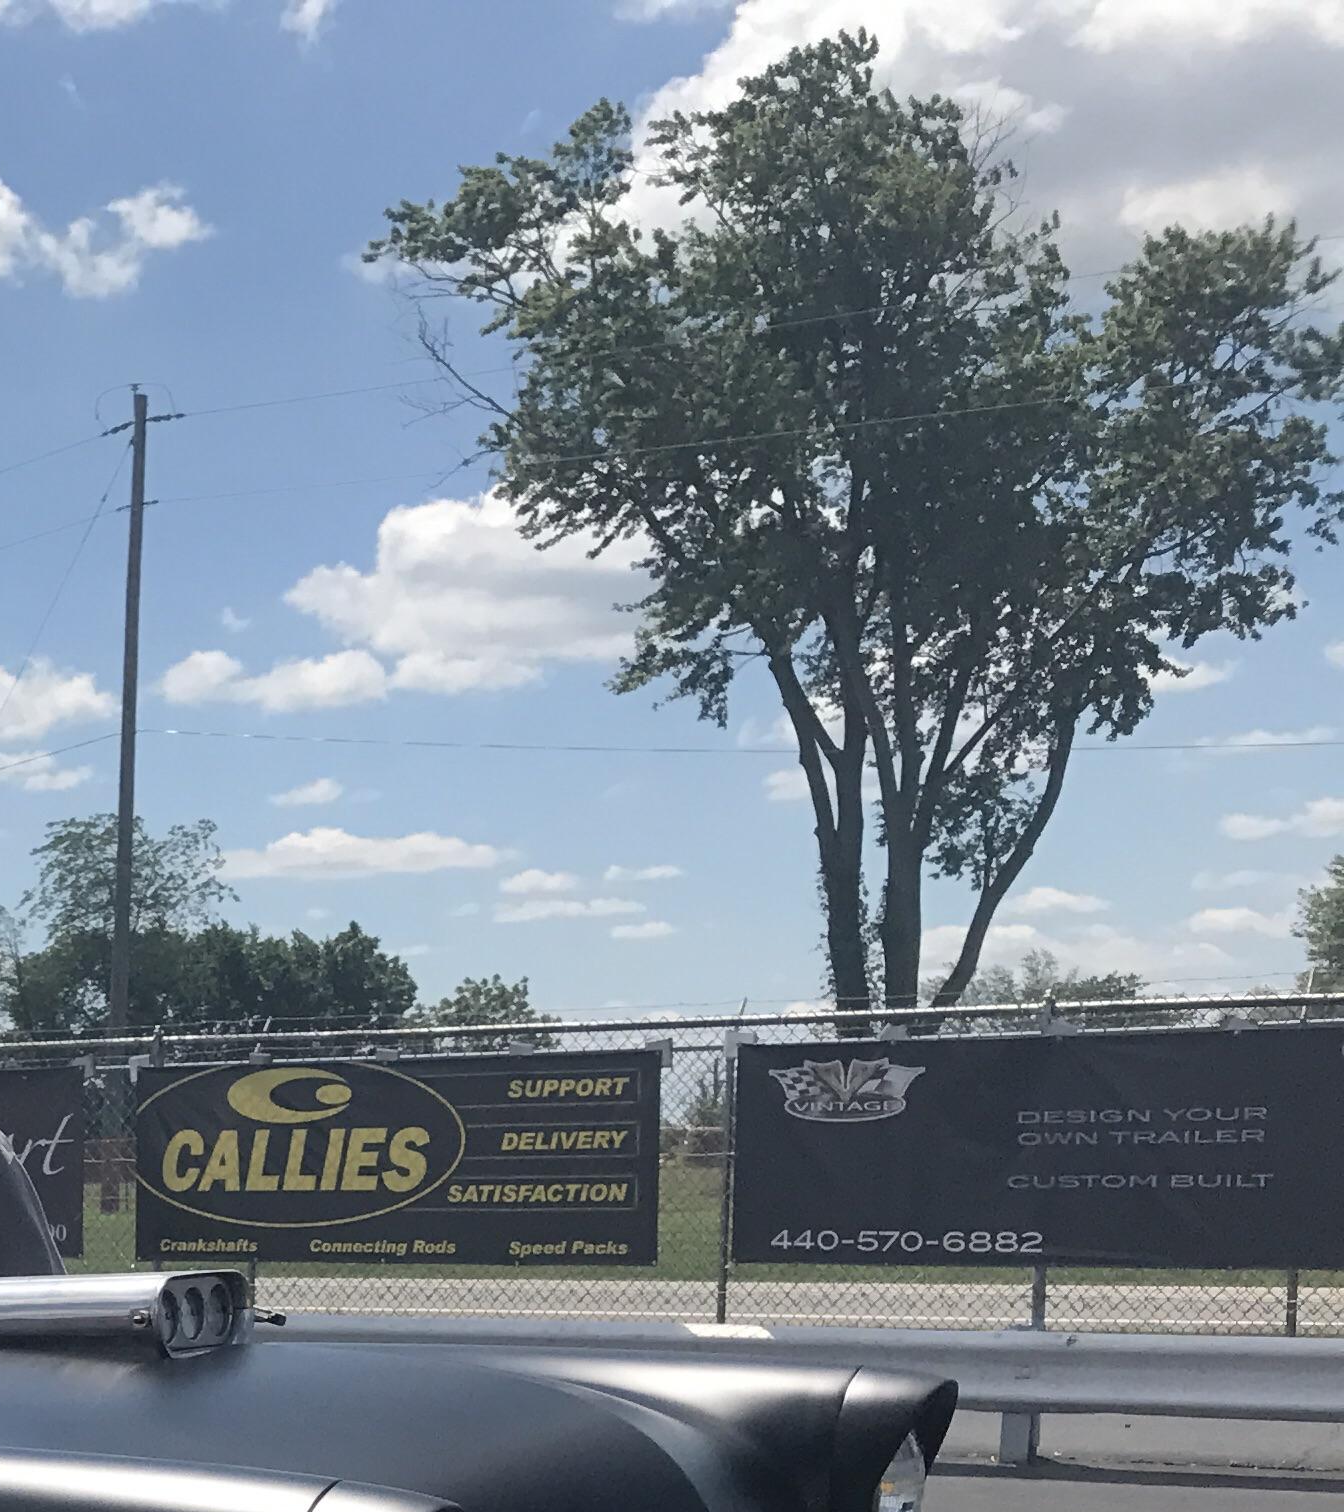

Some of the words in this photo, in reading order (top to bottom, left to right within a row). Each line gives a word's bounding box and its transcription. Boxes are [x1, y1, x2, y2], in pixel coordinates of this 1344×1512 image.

[507, 1076, 630, 1099] SUPPORT
[1016, 1109, 1151, 1124] DESIGN
[1163, 1107, 1268, 1121] YOUR
[501, 1129, 629, 1152] DELIVERY
[1017, 1131, 1099, 1146] OWN
[1109, 1129, 1265, 1144] TRAILER
[161, 1126, 431, 1193] CALLIES
[1006, 1174, 1158, 1189] CUSTOM
[1170, 1173, 1274, 1188] BUILT
[446, 1183, 628, 1204] SATISFACTION
[159, 1238, 259, 1253] Crankshafts
[309, 1238, 409, 1257] Connecting
[413, 1239, 457, 1255] Rods
[508, 1240, 566, 1258] Speed
[570, 1240, 629, 1256] Packs
[770, 1229, 1044, 1254] 440-570-6882
